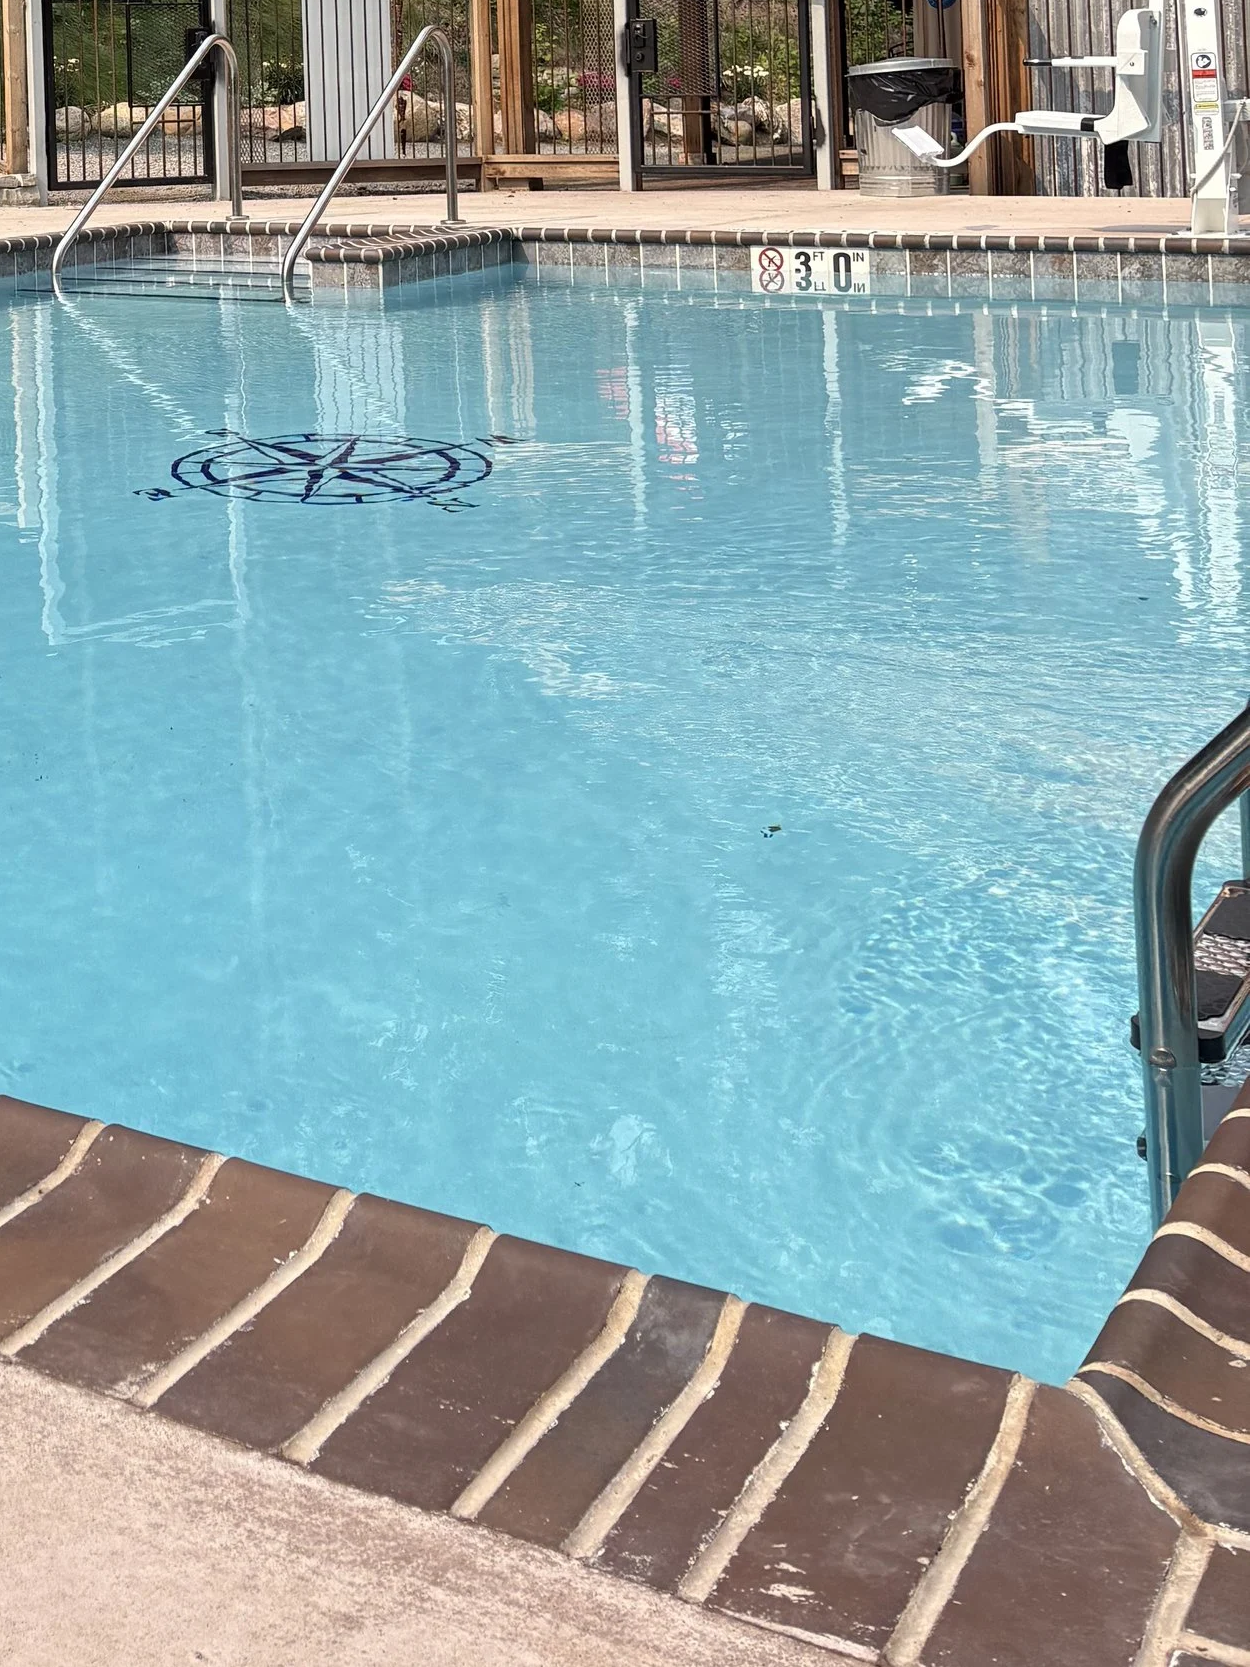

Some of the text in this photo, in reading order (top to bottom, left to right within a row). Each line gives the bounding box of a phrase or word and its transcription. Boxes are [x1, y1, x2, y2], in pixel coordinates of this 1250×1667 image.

[795, 251, 865, 274] 3 FT 0 IN
